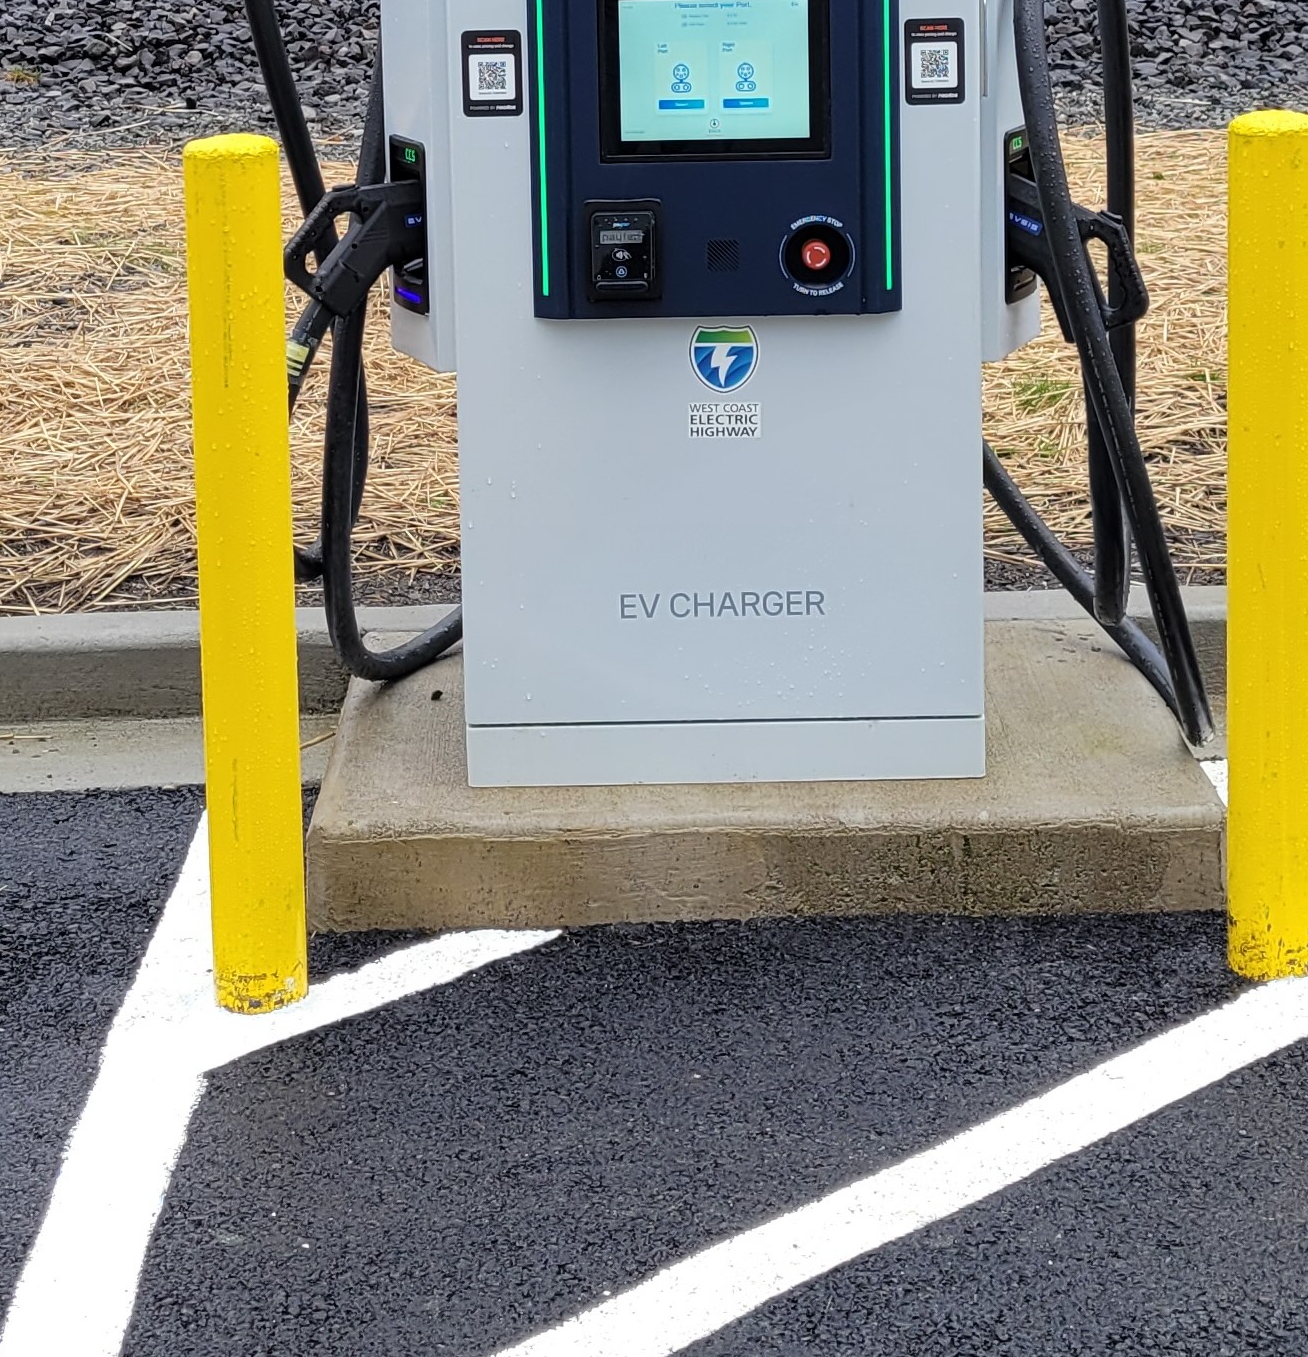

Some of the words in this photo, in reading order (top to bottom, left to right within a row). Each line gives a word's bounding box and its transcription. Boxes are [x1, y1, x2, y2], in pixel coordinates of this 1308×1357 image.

[405, 147, 416, 162] CCS
[790, 215, 827, 230] EMERGENCY
[827, 217, 843, 228] STOP
[793, 282, 809, 295] TURN
[818, 281, 844, 296] RELEASE
[689, 403, 720, 413] WEST
[723, 403, 759, 413] COAST
[690, 414, 758, 425] ELECTRIC
[690, 426, 758, 437] HIGHWAY
[620, 593, 660, 619] EV
[669, 590, 826, 618] CHARGER
